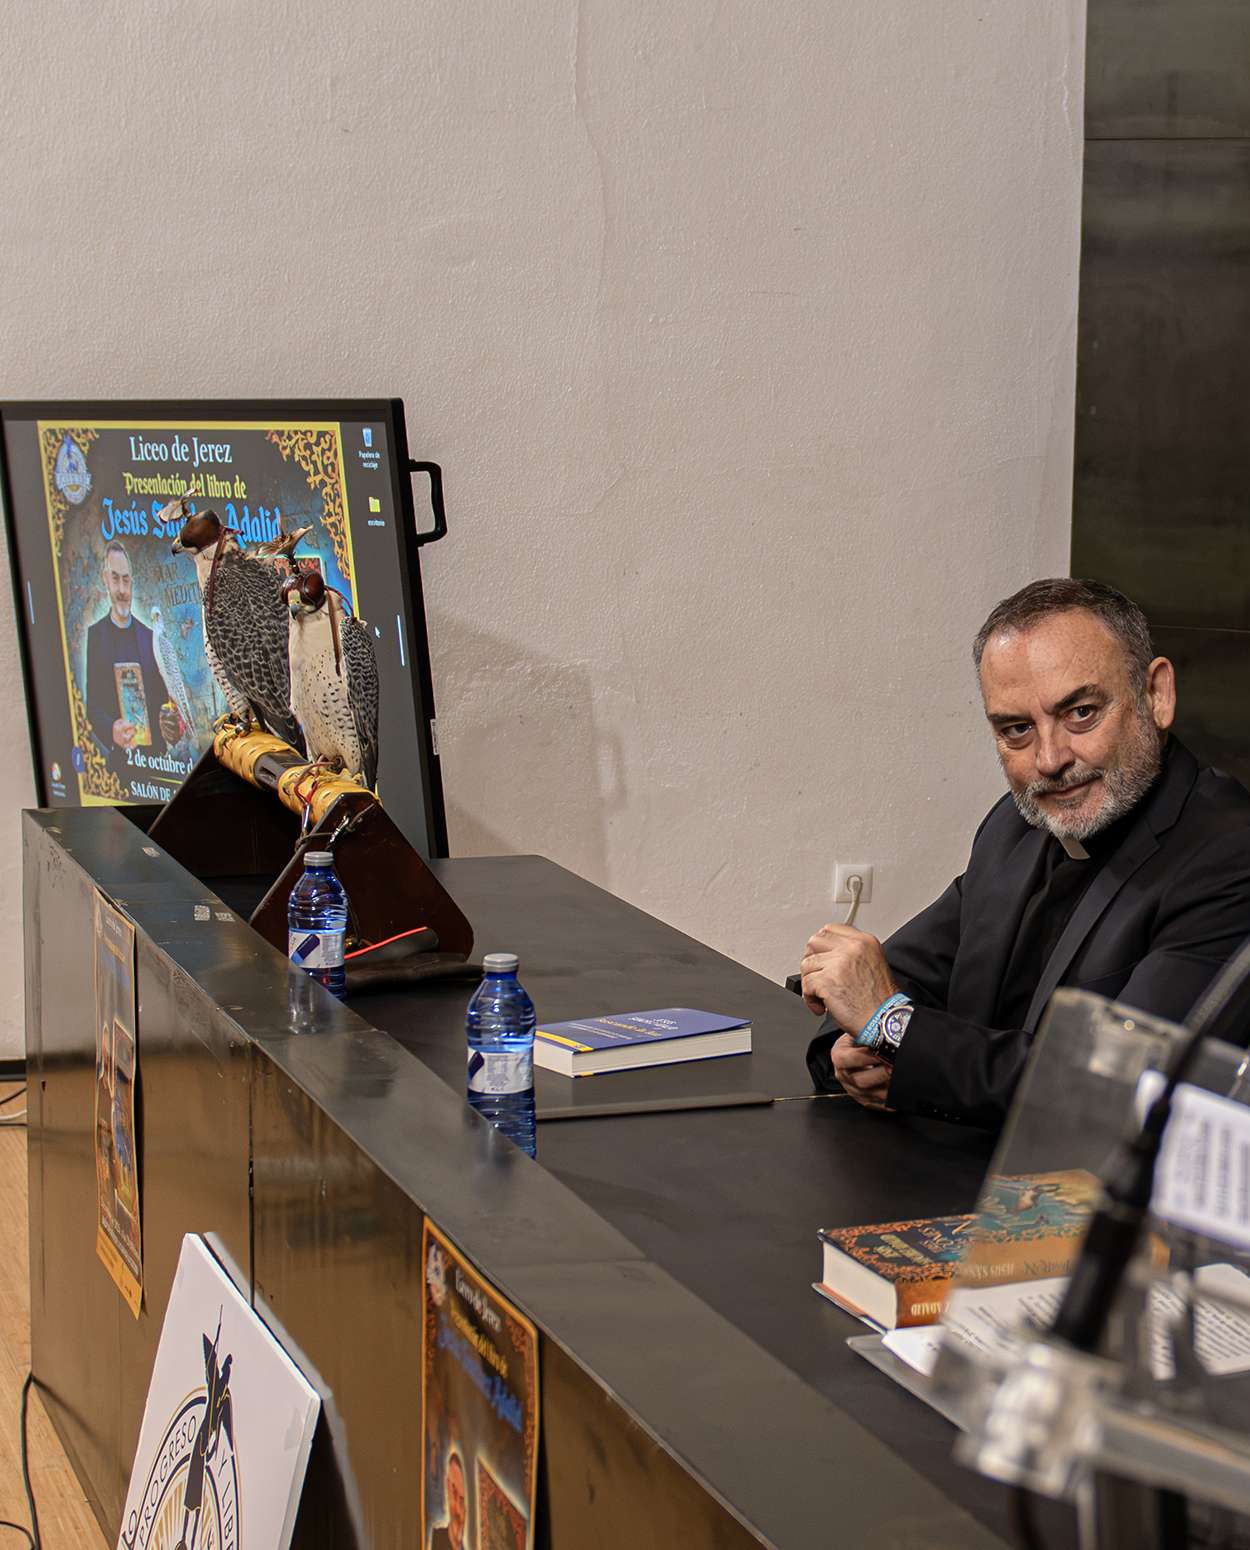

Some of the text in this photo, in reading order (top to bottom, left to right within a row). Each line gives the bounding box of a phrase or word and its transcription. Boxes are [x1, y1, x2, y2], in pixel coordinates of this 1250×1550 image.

[129, 434, 232, 468] Liceo de Jerez
[122, 472, 186, 496] Presentación
[207, 474, 231, 499] libro
[233, 475, 247, 499] de
[101, 497, 149, 542] Jesús
[225, 503, 281, 549] Adalid
[126, 747, 134, 766] 2
[135, 748, 147, 768] de
[130, 780, 159, 800] SALÓN
[160, 786, 171, 802] DE
[138, 1415, 197, 1548] PROGRESO
